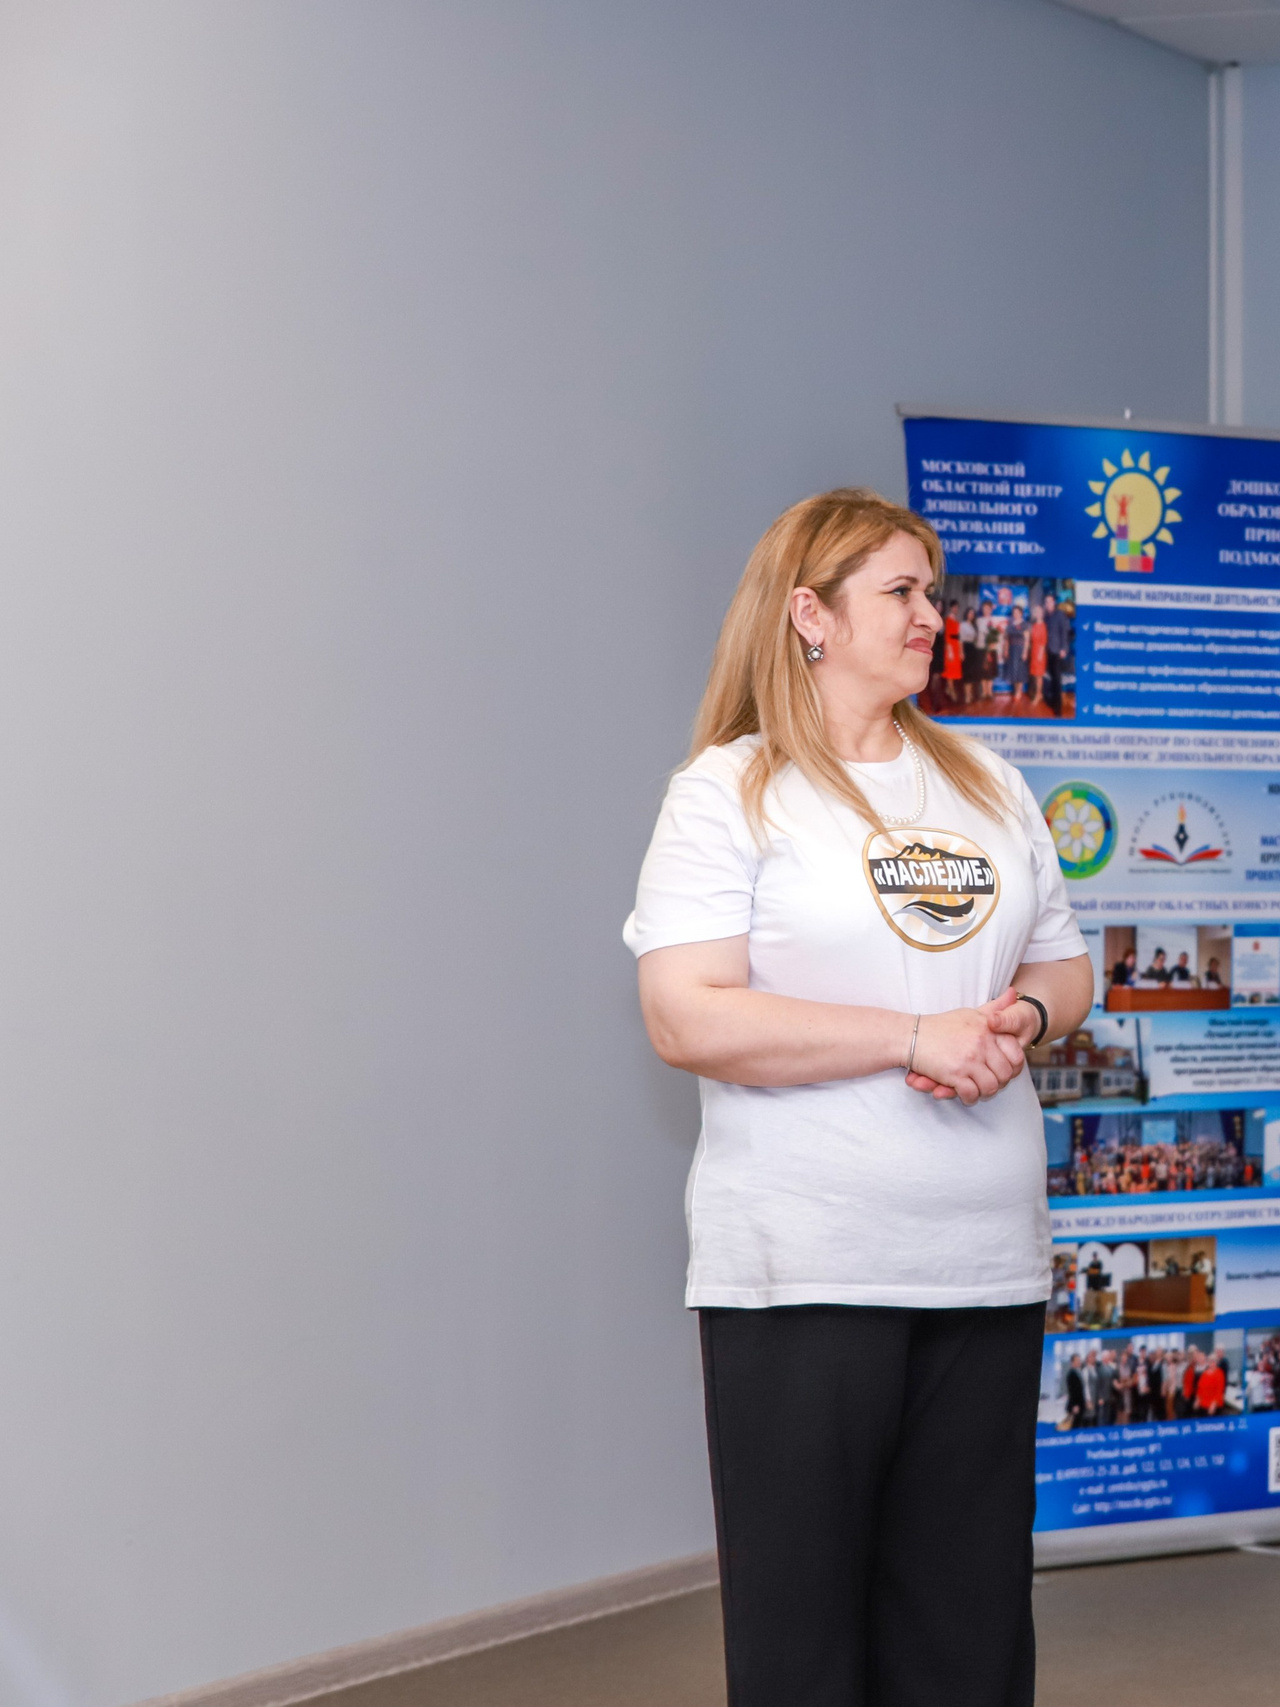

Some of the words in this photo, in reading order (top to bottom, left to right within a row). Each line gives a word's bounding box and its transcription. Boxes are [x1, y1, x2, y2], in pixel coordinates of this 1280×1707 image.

[921, 460, 1026, 477] МОСКОВСКИЙ
[921, 479, 1010, 496] ОБЛАСТНОЙ
[1013, 483, 1063, 498] ЦЕНТР
[922, 499, 1038, 516] ДОШКОЛЬНОГО
[1092, 588, 1142, 601] ОСНОВНЫЕ
[1145, 591, 1212, 605] НАПРАВЛЕНИЯ
[1017, 732, 1111, 745] РЕГИОНАЛЬНЫЙ
[1113, 734, 1171, 746] ОПЕРАТОР
[1173, 737, 1192, 747] ПО
[874, 860, 994, 892] «НАСЛЕДИЕ»
